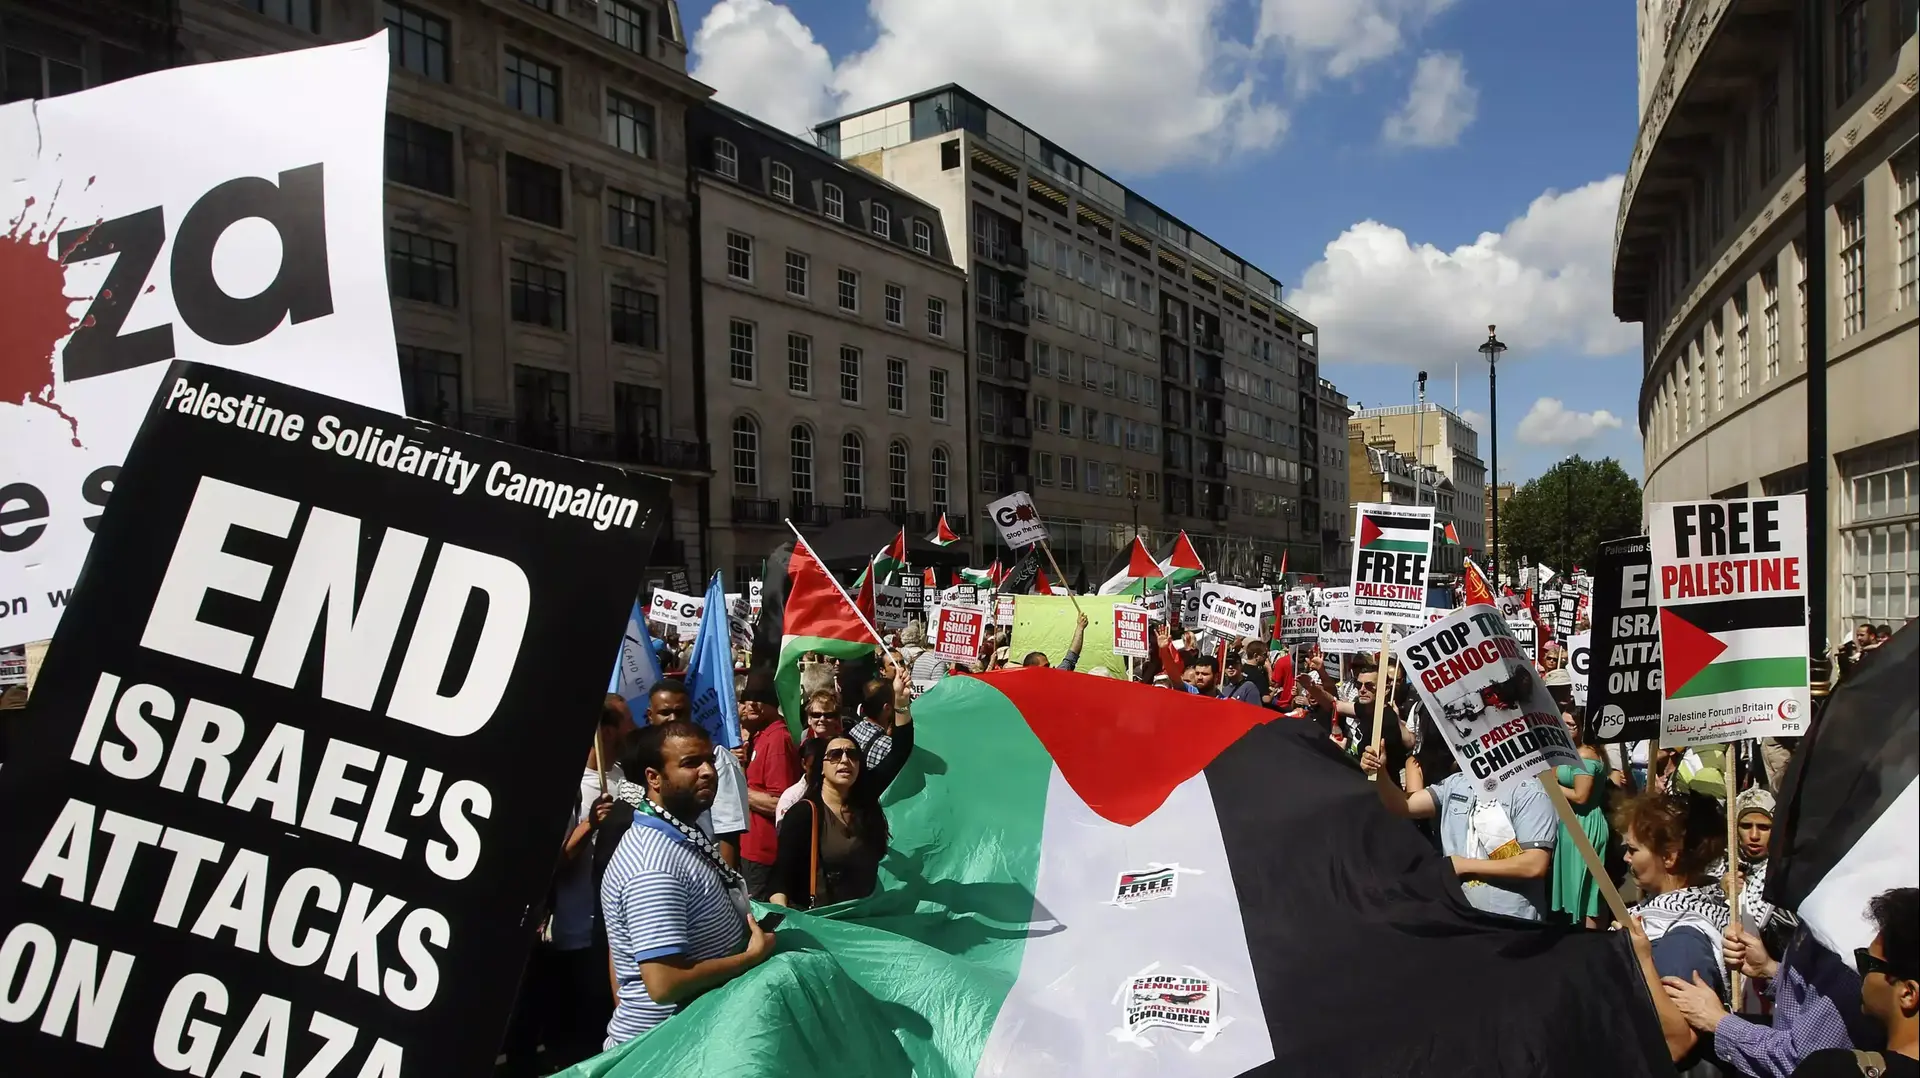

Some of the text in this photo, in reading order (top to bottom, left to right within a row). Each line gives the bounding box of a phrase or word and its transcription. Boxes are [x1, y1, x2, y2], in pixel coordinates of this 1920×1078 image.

[0, 162, 334, 382] za
[165, 377, 639, 530] Palestine Solidarity Campaign
[1006, 531, 1022, 540] Stop
[1021, 526, 1032, 534] the
[1673, 500, 1780, 558] FREE
[1604, 543, 1644, 556] Palestine
[1357, 550, 1427, 586] FREE
[902, 576, 920, 586] END
[1661, 557, 1800, 599] PALESTINE
[960, 586, 975, 594] END
[1355, 582, 1423, 601] PALESTINE
[140, 475, 531, 737] END
[1214, 604, 1238, 619] END THE
[1539, 603, 1555, 613] END
[1561, 598, 1575, 611] END
[949, 611, 973, 623] STOP
[1121, 611, 1140, 621] STOP
[1282, 617, 1318, 628] UK: STOP
[943, 621, 977, 635] ISRAELI
[1117, 620, 1144, 632] ISRAELI
[945, 632, 972, 645] STATE
[1121, 629, 1141, 640] STATE
[940, 642, 974, 656] TERROR
[1117, 638, 1145, 650] TERROR
[1406, 621, 1471, 671] STOP
[1609, 642, 1661, 667] ATTA
[1420, 637, 1525, 693] GENOCIDE
[1575, 683, 1589, 691] Sto
[1608, 670, 1640, 694] ON
[1628, 713, 1661, 722] www.pale
[1668, 703, 1774, 723] Palestine Forum in Britain
[1603, 714, 1624, 727] PSC
[1782, 723, 1800, 731] PFB
[1462, 711, 1562, 759] OF PALESTINIAN
[1470, 726, 1573, 780] CHILDREN
[70, 671, 492, 881] ISRAEL'S
[1499, 767, 1516, 782] GUPS
[1514, 763, 1524, 774] UK
[1118, 878, 1173, 895] FREE
[21, 797, 451, 1012] ATTACKS
[0, 921, 135, 1048] ON
[1133, 983, 1211, 992] GENOCIDE
[1180, 977, 1208, 985] THE
[1144, 1004, 1210, 1016] PALESTINIAN
[1129, 1010, 1210, 1025] CHILDREN
